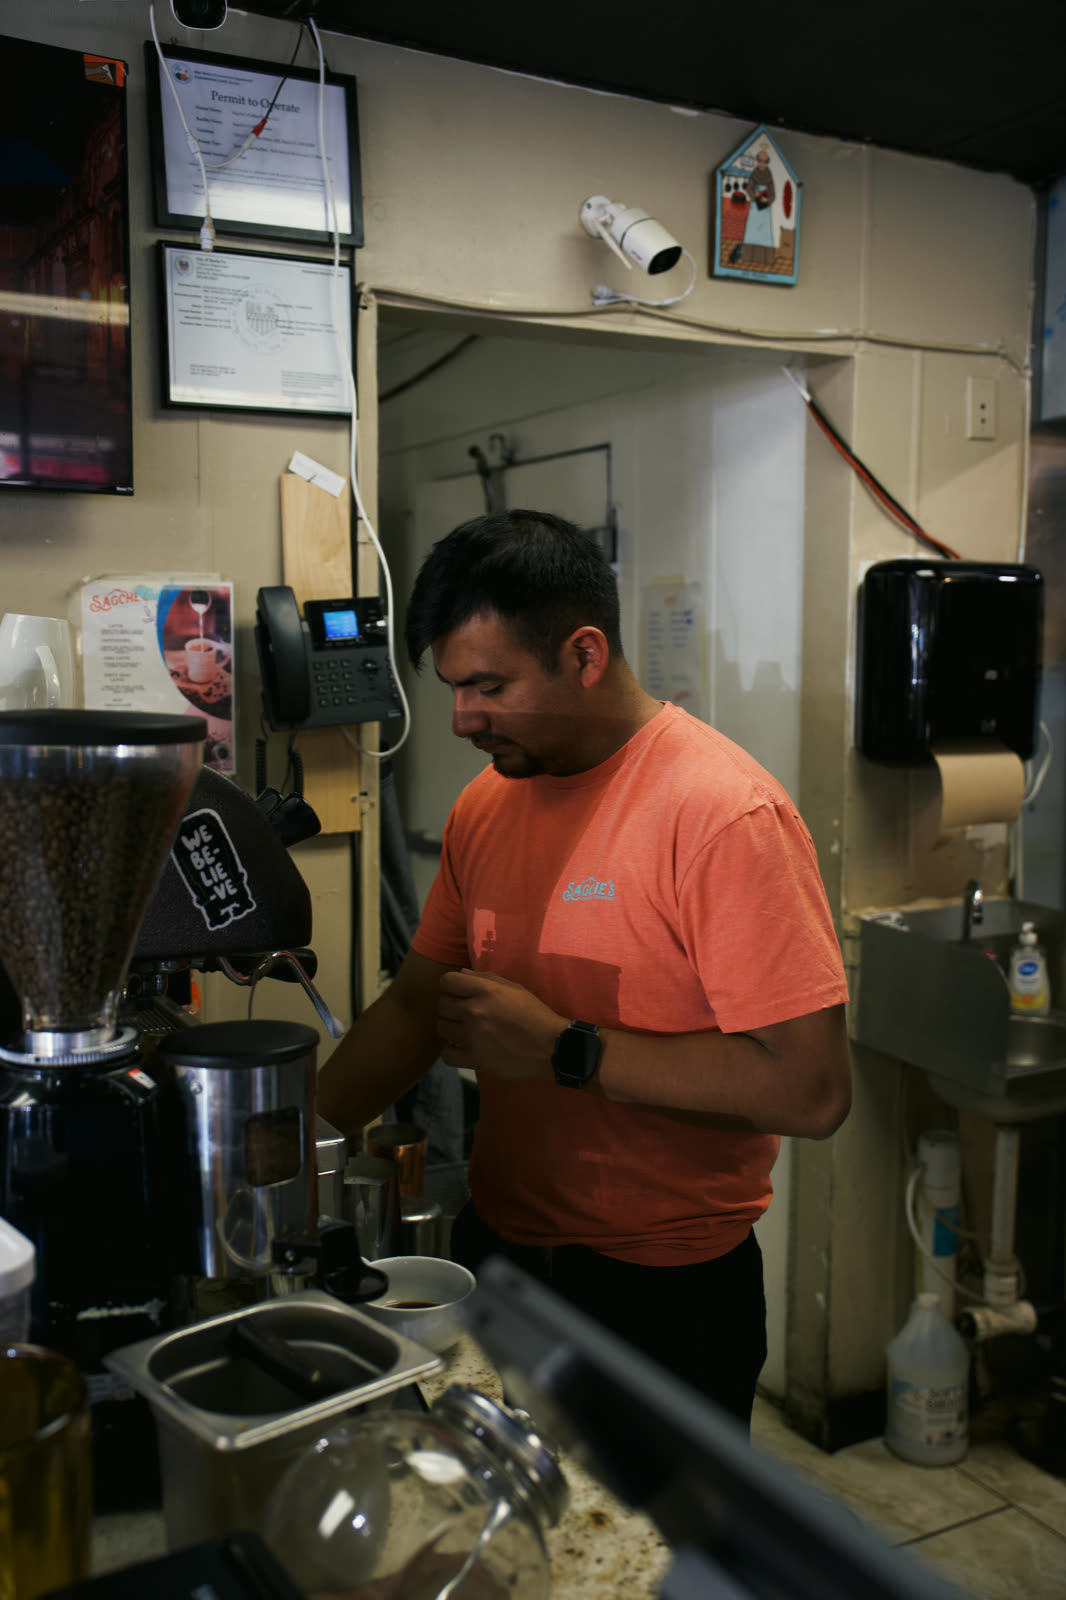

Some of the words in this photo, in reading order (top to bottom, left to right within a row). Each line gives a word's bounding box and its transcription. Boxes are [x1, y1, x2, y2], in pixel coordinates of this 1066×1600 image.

[211, 90, 246, 105] Permit
[247, 97, 259, 107] to
[260, 97, 301, 114] Operate
[181, 824, 213, 851] WE
[190, 845, 220, 870] BE-
[200, 862, 228, 887] LIE
[209, 878, 238, 901] -VE
